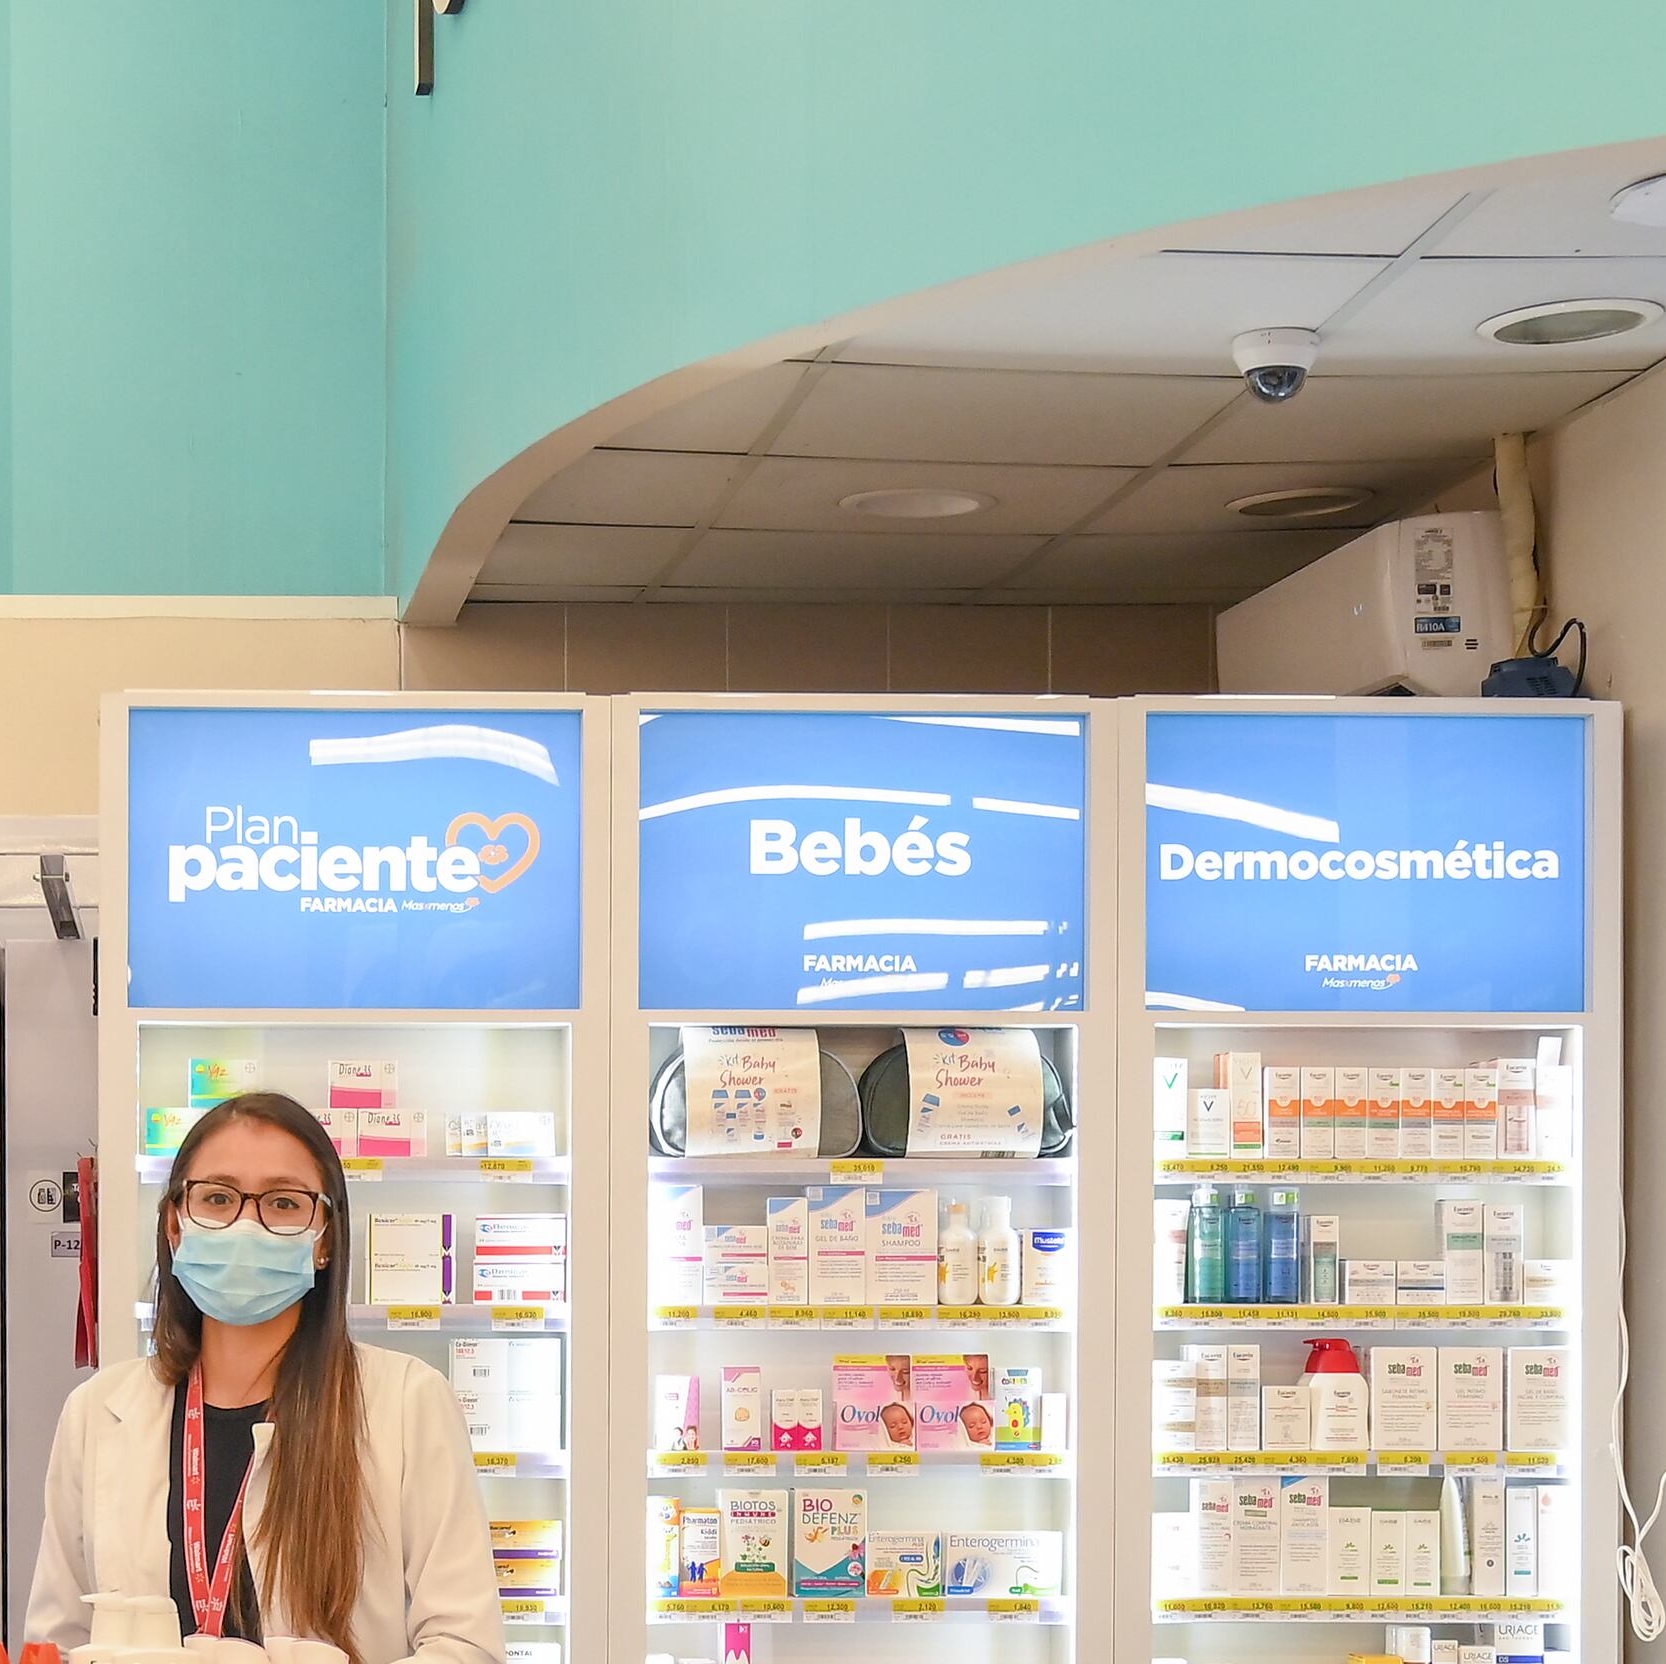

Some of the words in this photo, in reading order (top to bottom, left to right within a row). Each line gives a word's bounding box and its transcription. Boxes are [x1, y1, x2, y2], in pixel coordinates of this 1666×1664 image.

[206, 805, 298, 844] Plan
[750, 815, 971, 876] Bebés
[169, 832, 481, 902] paciente
[1160, 840, 1559, 880] Dermocosmética
[301, 898, 397, 913] FARMACIA
[804, 955, 917, 972] FARMACIA
[1305, 955, 1418, 972] FARMACIA
[720, 1070, 765, 1088] Shower
[54, 1239, 80, 1250] P-12
[881, 1239, 921, 1247] SHAMPOO
[841, 1405, 881, 1423] Ovol
[730, 1500, 776, 1511] BIOTOS
[802, 1498, 832, 1512] BIO
[802, 1513, 857, 1525] DEFENZ
[868, 1534, 925, 1545] Enterogermina
[949, 1535, 1040, 1551] Enterogermina
[1463, 1650, 1493, 1662] URIAGE
